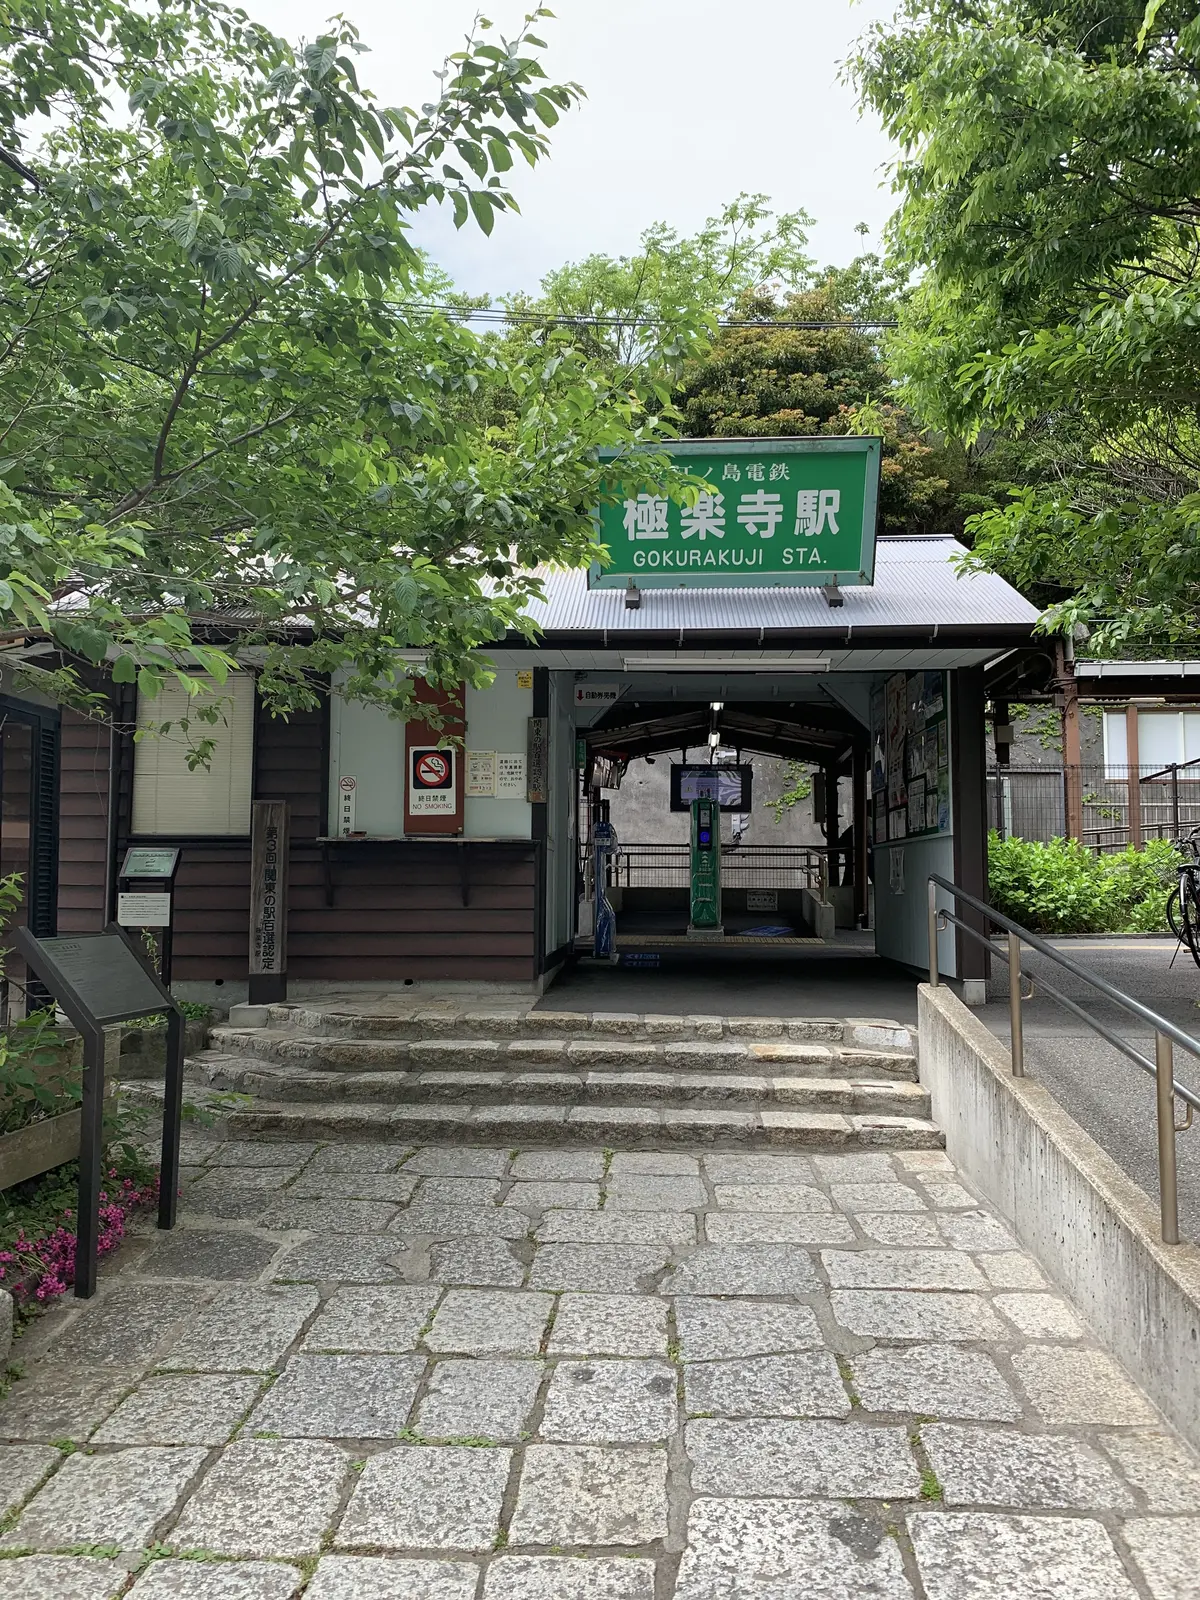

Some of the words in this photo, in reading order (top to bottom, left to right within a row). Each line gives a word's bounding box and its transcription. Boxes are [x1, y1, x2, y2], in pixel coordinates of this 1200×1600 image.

[622, 489, 840, 541] 極楽寺駅
[633, 549, 764, 568] GOKURAKUJI
[782, 547, 828, 565] STA.
[585, 691, 617, 700] 自動券売機
[418, 795, 447, 803] 終日禁煙
[424, 802, 453, 810] SMOKING
[342, 794, 352, 835] 終日禁煙
[262, 826, 278, 970] 第3回関東の駅百選認定
